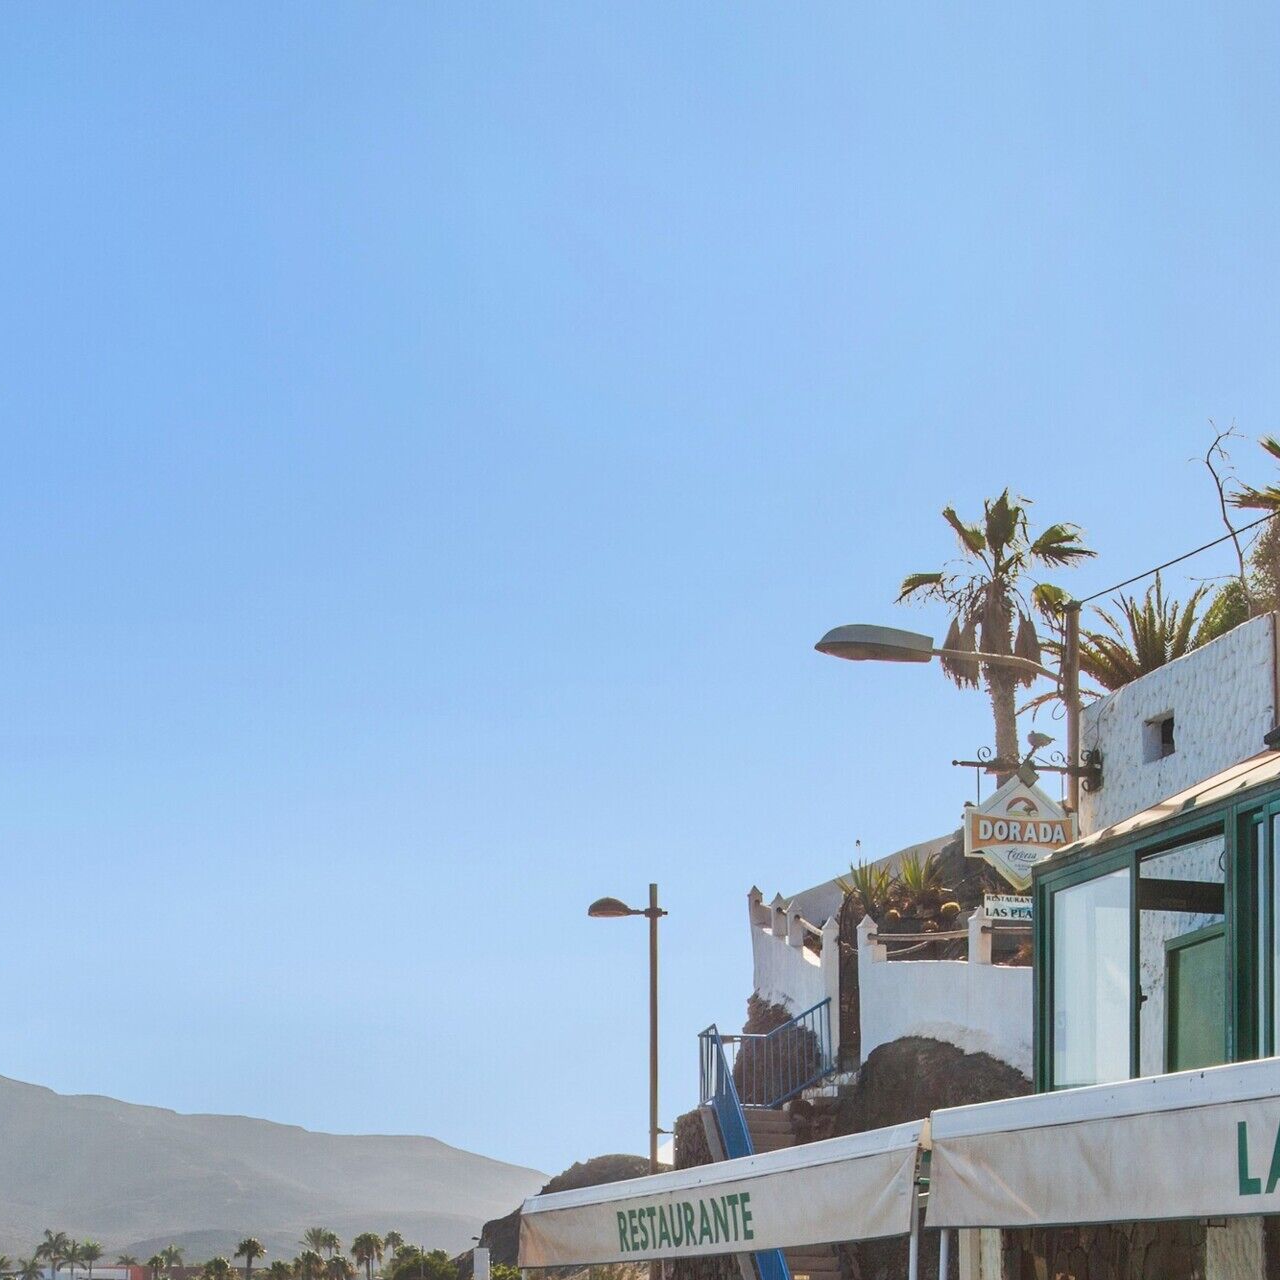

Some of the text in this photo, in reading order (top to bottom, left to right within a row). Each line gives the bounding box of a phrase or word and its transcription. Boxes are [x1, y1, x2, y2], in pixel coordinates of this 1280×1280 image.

[979, 820, 1066, 844] DORADA
[986, 907, 1008, 918] LAS
[617, 1192, 754, 1252] RESTAURANTE
